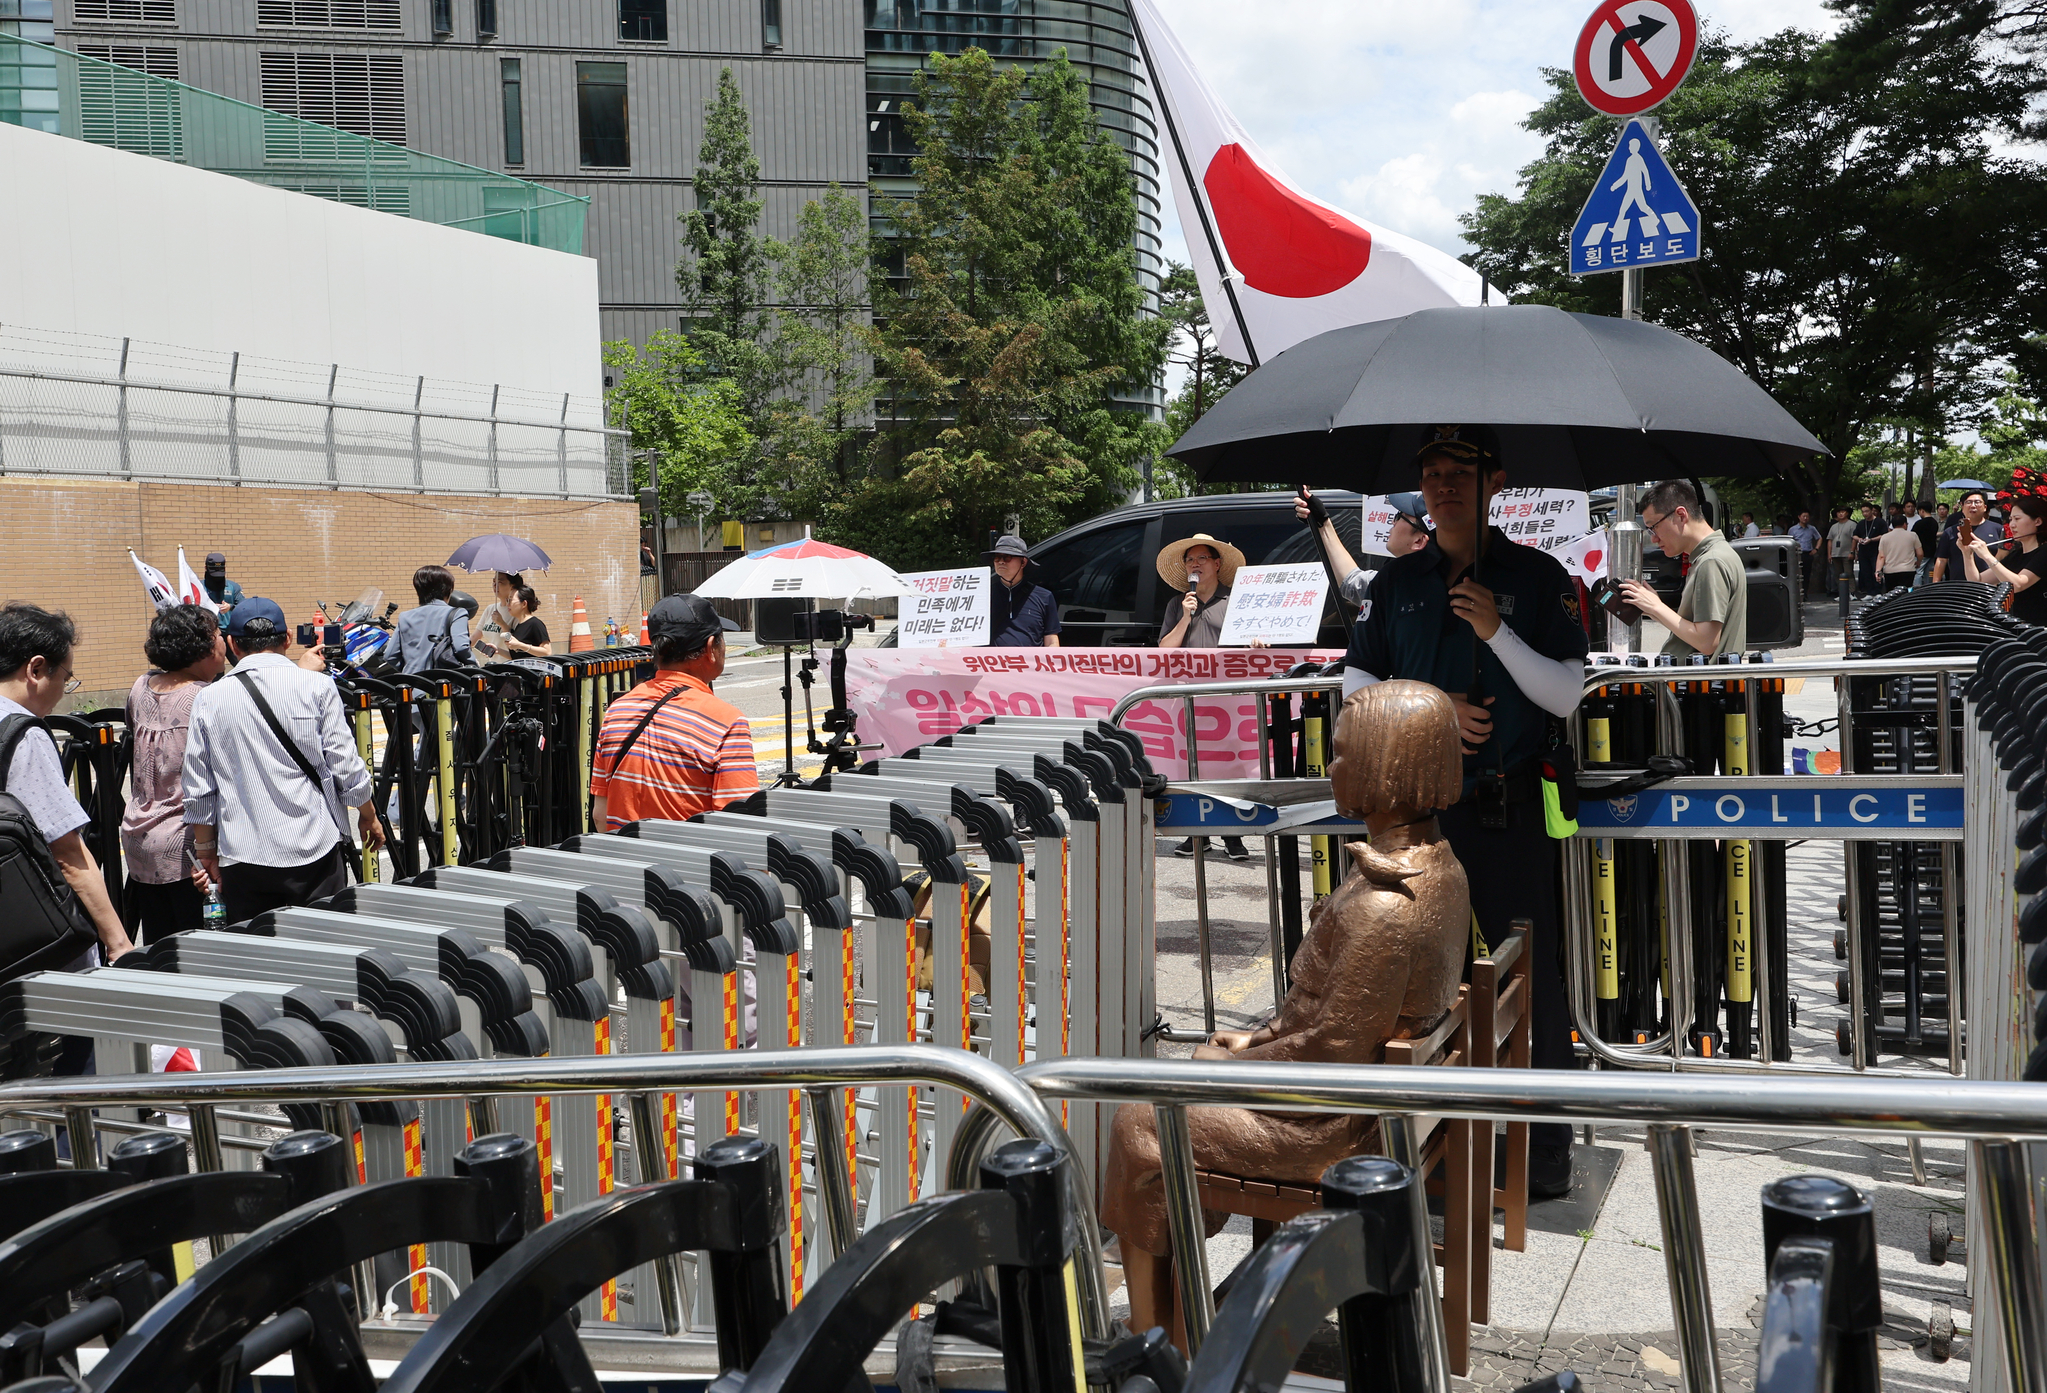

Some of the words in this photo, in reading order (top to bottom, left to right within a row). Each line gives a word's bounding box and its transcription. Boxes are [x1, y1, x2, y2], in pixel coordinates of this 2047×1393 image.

[1584, 238, 1685, 267] 횡단보도
[1498, 487, 1545, 501] 우리가
[913, 574, 980, 593] 거짓말하는
[917, 595, 974, 614] 민족에게
[1235, 589, 1318, 610] 慰安婦詐欺
[904, 618, 946, 635] 미래는
[950, 616, 985, 633] 없다!
[1232, 614, 1313, 631] 今すぐやめて!
[962, 654, 1029, 673] 위안부
[1034, 654, 1142, 677] 사기집단의
[1147, 653, 1219, 679] 거짓과
[1223, 654, 1296, 679] 증오로
[1671, 793, 1927, 823] POLICE
[1600, 899, 1613, 971] LINE
[1734, 900, 1746, 972] LINE
